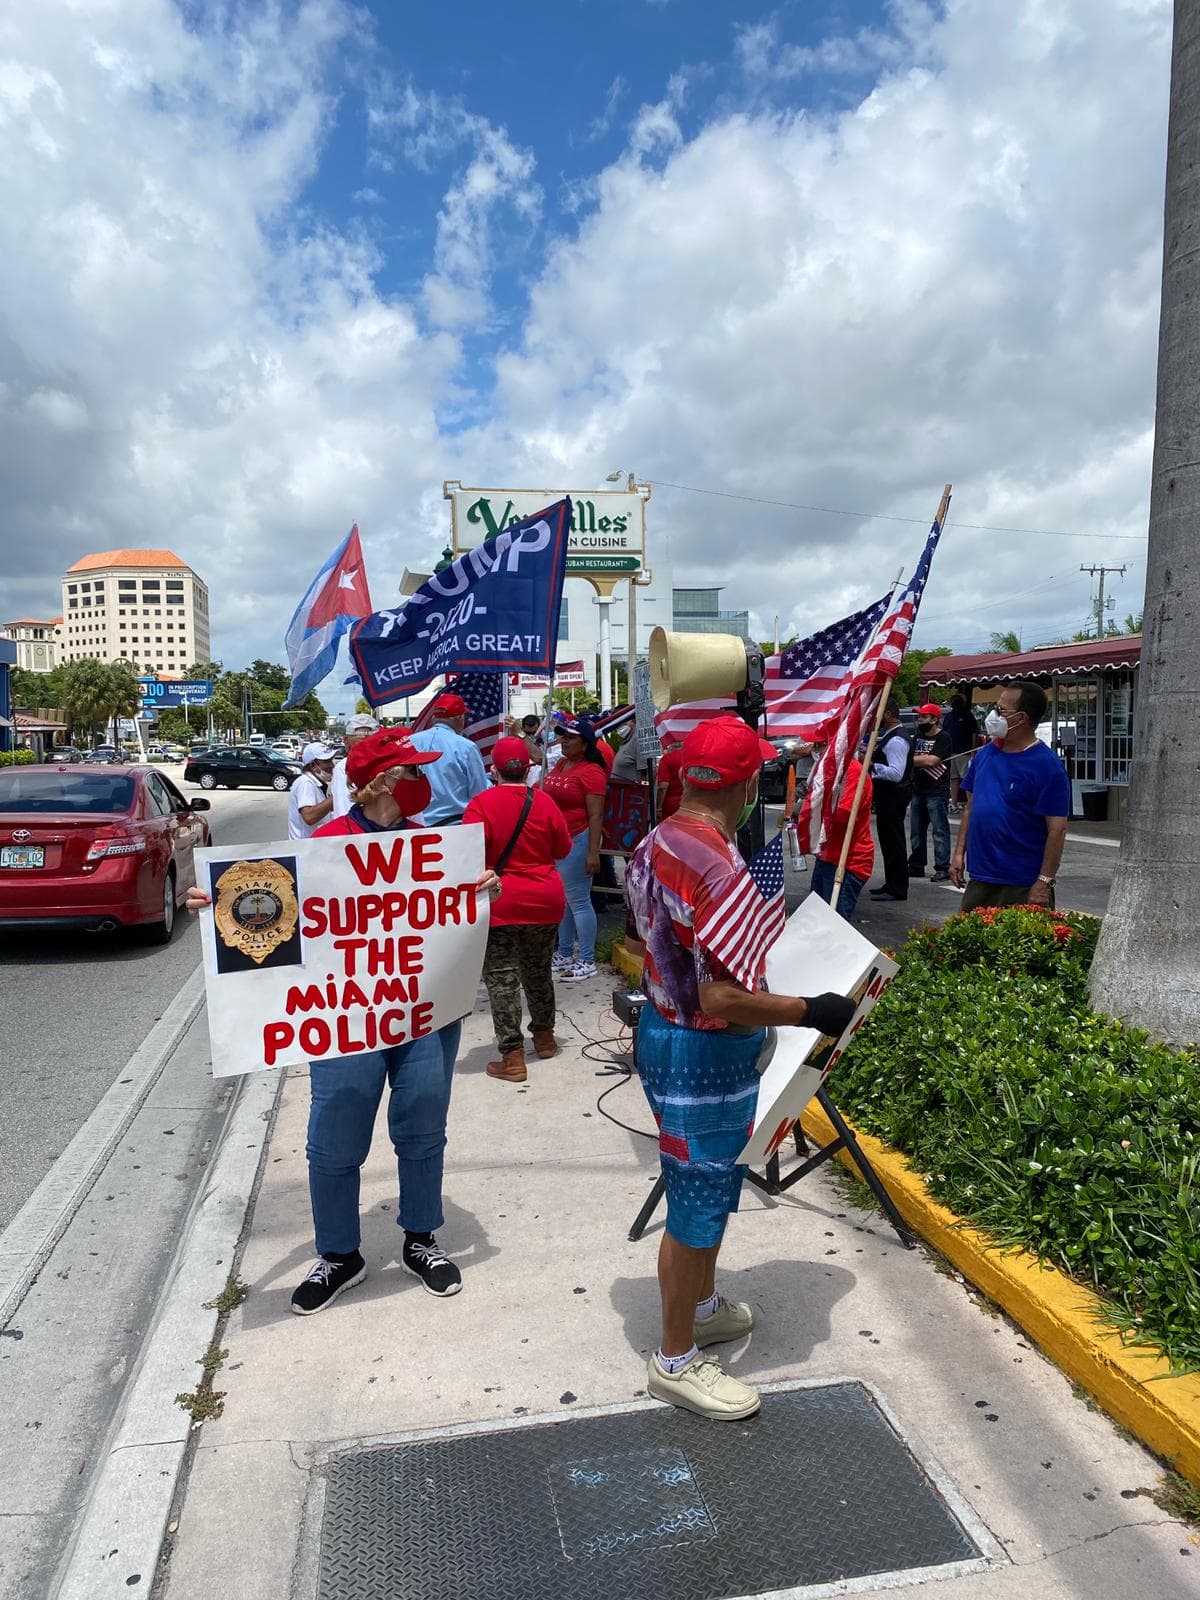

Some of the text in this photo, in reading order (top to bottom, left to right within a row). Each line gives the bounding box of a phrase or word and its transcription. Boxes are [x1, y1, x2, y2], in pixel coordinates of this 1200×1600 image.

[580, 537, 627, 547] CUISINE
[585, 559, 624, 568] RESTAURANT
[374, 657, 423, 685] KEEP
[465, 633, 541, 653] GREAT!
[344, 833, 445, 886] WE
[234, 881, 279, 893] MIAMI
[302, 883, 479, 938] SUPPORT
[232, 927, 282, 941] POLICE
[333, 936, 424, 977] THE
